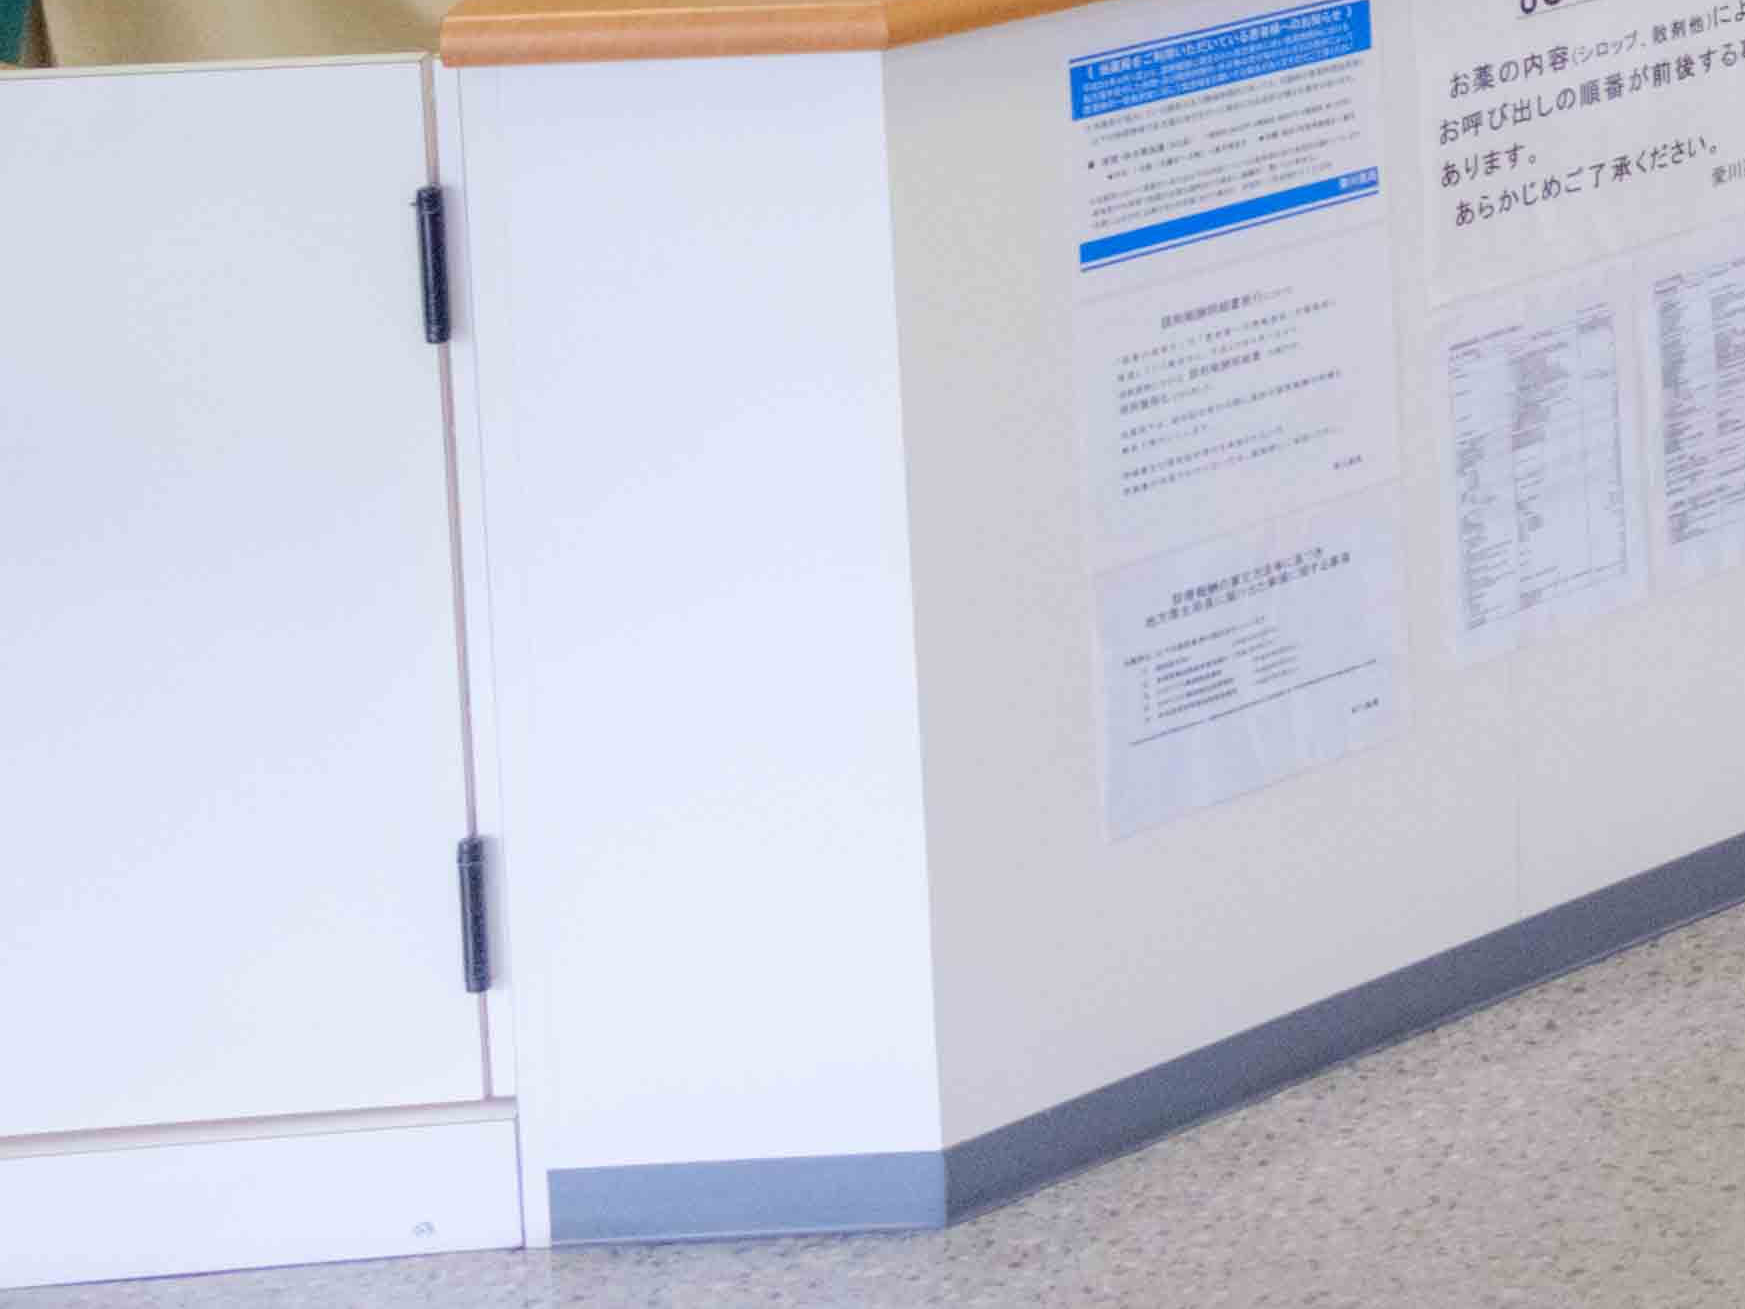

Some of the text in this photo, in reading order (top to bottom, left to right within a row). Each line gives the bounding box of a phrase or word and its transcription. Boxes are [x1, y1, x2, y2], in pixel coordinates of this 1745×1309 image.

[1440, 141, 1538, 189] あります。
[1454, 135, 1718, 227] あらかじめご了承ください。
